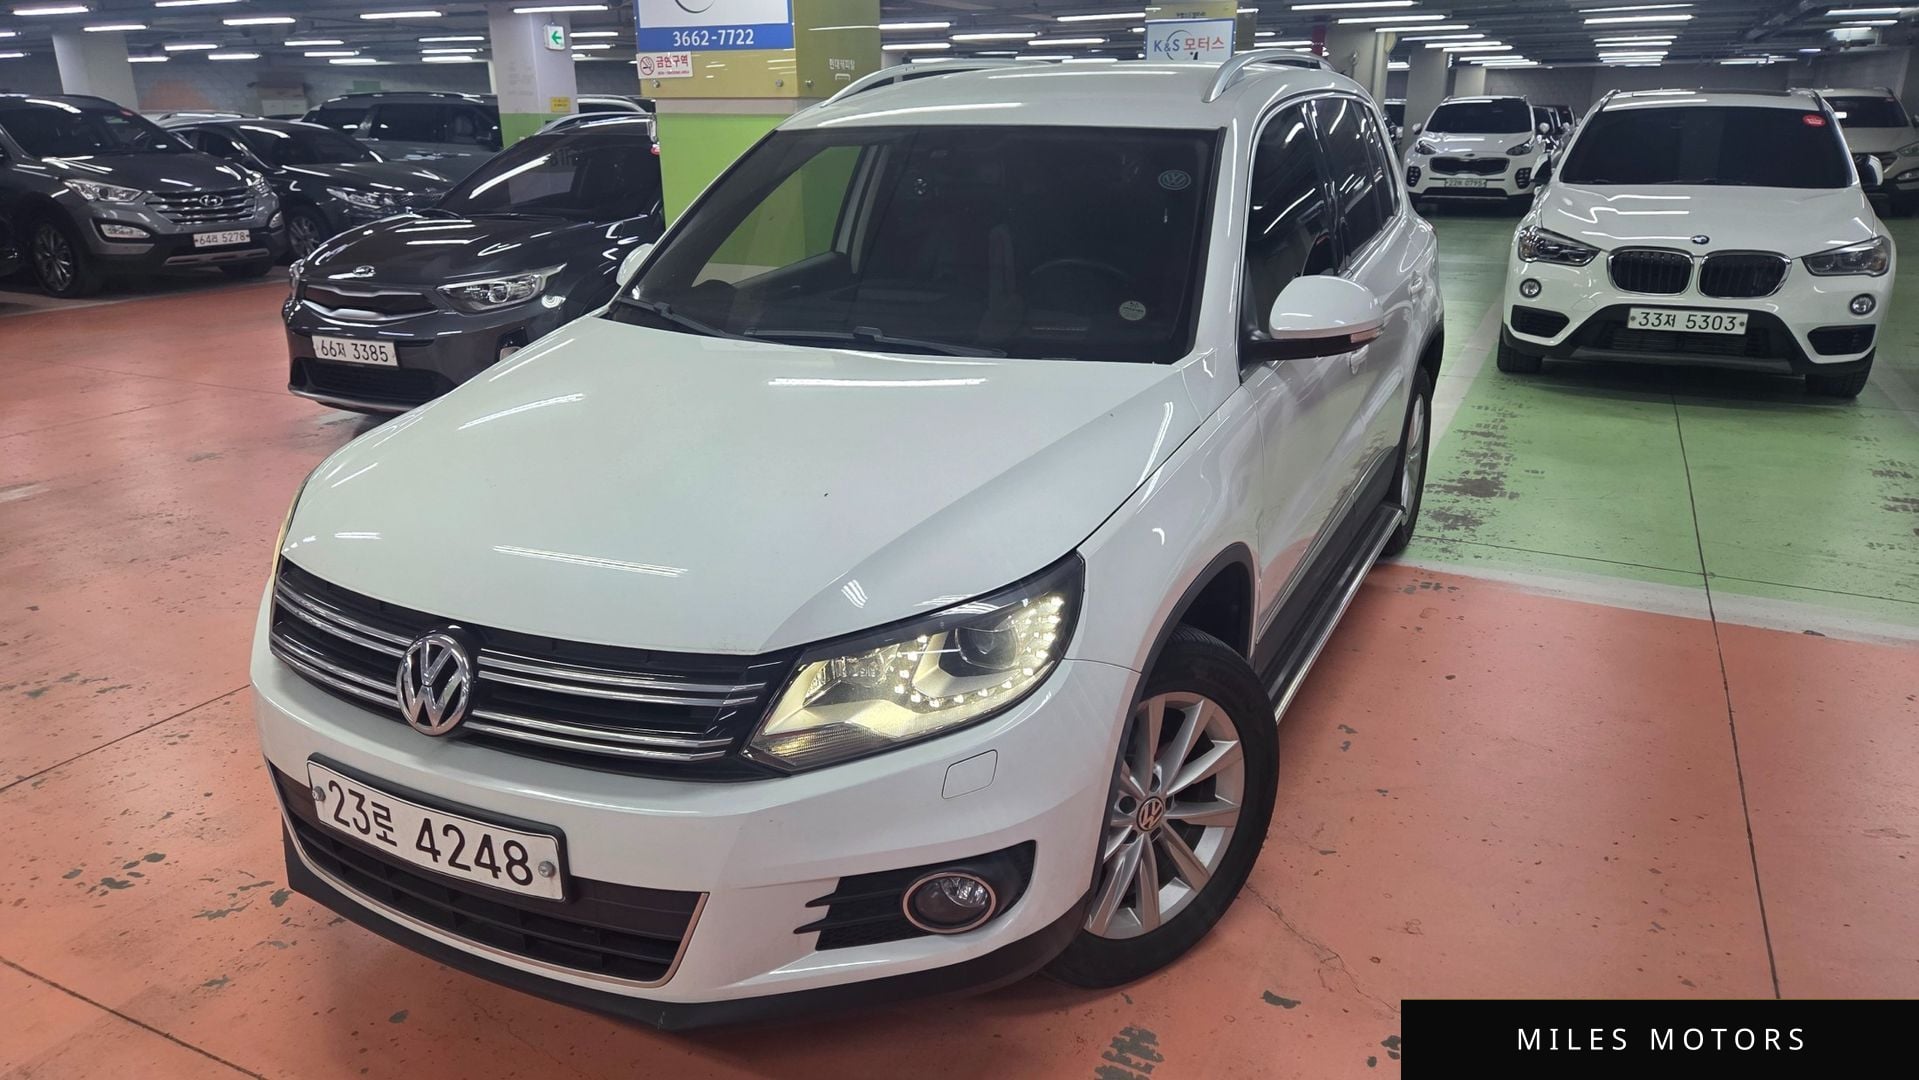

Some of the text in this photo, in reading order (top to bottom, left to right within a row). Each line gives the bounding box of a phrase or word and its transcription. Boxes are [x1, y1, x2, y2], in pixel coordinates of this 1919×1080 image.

[673, 29, 754, 46] 3662-7722
[1153, 36, 1224, 52] K&S 모터스
[656, 55, 689, 68] 금연구역
[222, 231, 245, 243] 5278
[1638, 311, 1737, 332] 33저 5303
[321, 340, 388, 362] 66저 3385
[328, 779, 533, 886] 23로 4248
